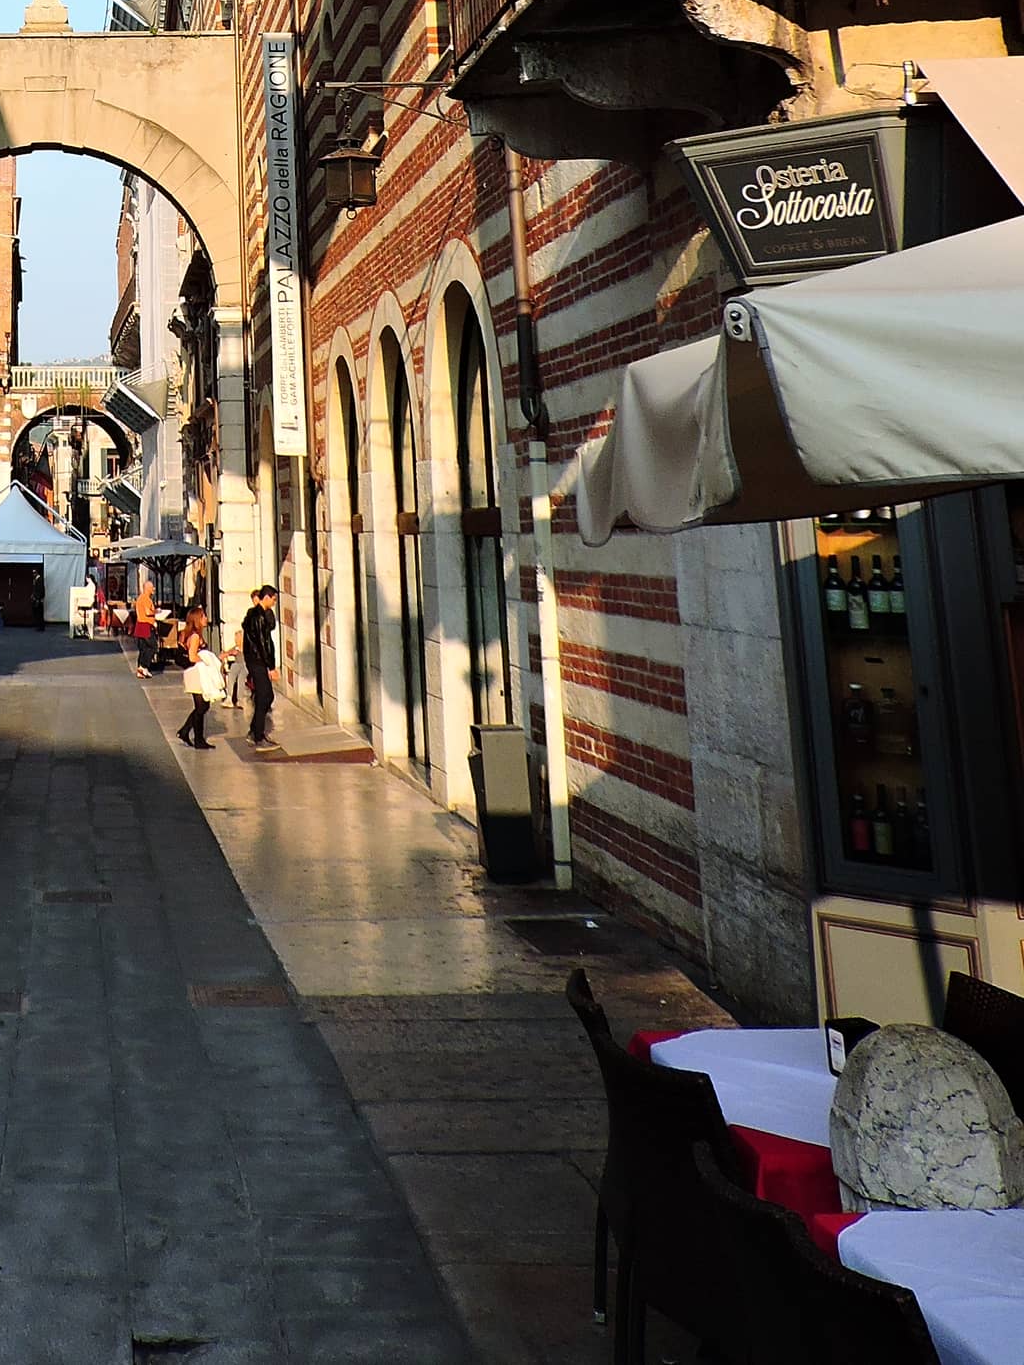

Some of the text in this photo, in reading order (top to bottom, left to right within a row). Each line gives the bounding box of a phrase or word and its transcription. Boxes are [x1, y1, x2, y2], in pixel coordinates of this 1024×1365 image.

[269, 42, 294, 303] PALAZZO della RAGIONE
[756, 158, 848, 191] Osteria
[736, 182, 874, 230] Sottocosta
[762, 235, 867, 255] COFFEE & BREAK
[278, 307, 288, 352] LAMBERTI
[286, 307, 298, 406] GAM ACHILLE FORTI
[279, 373, 289, 405] TORRE
